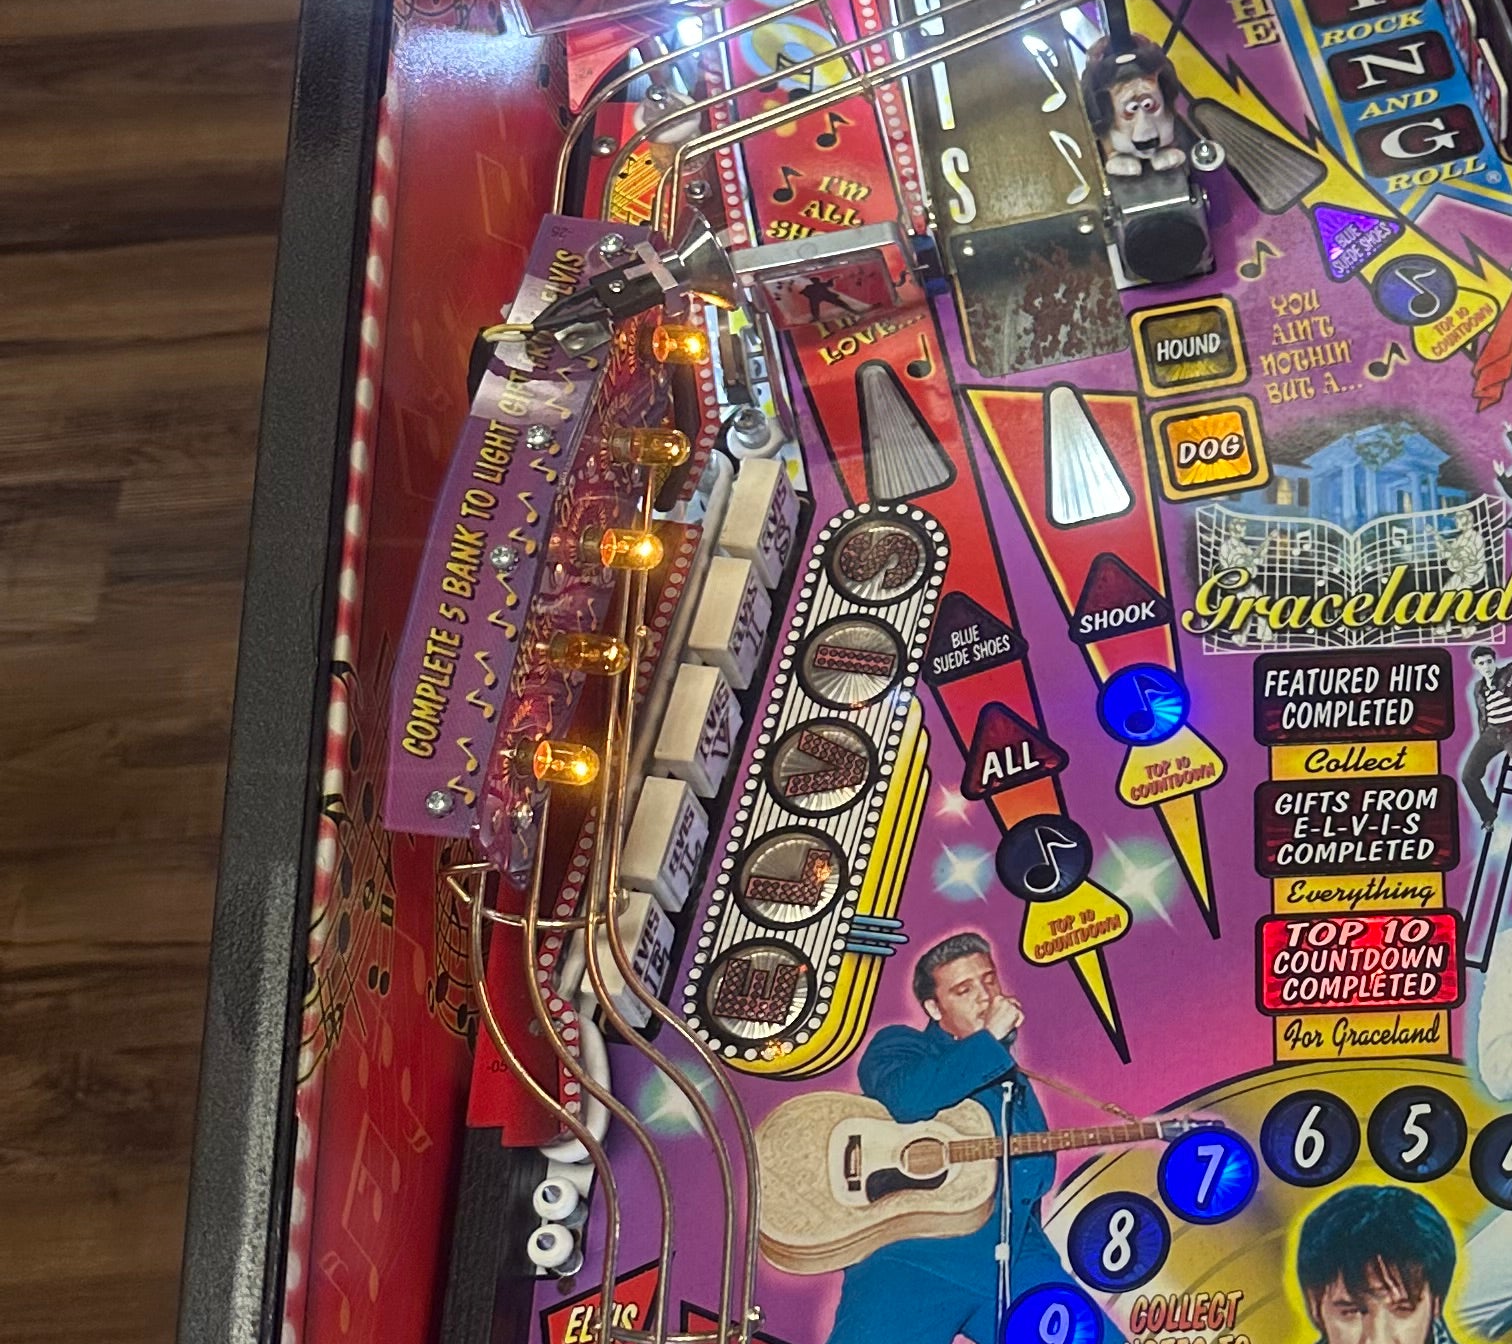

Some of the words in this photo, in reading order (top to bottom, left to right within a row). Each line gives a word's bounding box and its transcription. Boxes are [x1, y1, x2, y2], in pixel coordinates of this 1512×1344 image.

[1320, 9, 1426, 49] ROCK
[1356, 87, 1440, 121] AND
[1383, 158, 1488, 194] ROLL
[801, 202, 865, 229] ALL
[1334, 224, 1362, 249] BLUE
[1270, 288, 1322, 318] YOU
[1271, 314, 1335, 347] AIN'T
[1430, 303, 1495, 358] COUNTDOWN
[1432, 312, 1457, 337] TOP
[1156, 331, 1222, 363] HOUND
[1263, 374, 1316, 406] BUT
[471, 423, 523, 488] LIGHT
[1177, 432, 1246, 466] DOG
[460, 483, 497, 519] TO
[440, 514, 489, 599] BANK
[1079, 600, 1157, 635] SHOOK
[950, 624, 981, 648] BLUE
[933, 648, 971, 674] SUEDE
[972, 634, 1012, 663] SHOES
[400, 622, 466, 759] COMPLETE
[1264, 666, 1381, 698] FEATURED
[1388, 664, 1442, 693] HITS
[1281, 698, 1415, 732] COMPLETED
[980, 740, 1040, 786] ALL
[1143, 759, 1172, 780] TOP
[1175, 755, 1192, 772] 10
[1303, 746, 1409, 775] Collect
[1128, 762, 1216, 803] COUNTDOWN
[1274, 790, 1351, 817] GIFTS
[1361, 786, 1440, 813] FROM
[1293, 812, 1422, 840] E-L-V-I-S
[1276, 837, 1436, 867] COMPLETED
[1286, 875, 1437, 912] Everything
[1033, 912, 1122, 960] COUNTDOWN
[1046, 913, 1075, 937] TOP
[1078, 908, 1096, 926] 10
[1286, 920, 1365, 949] TOP
[1383, 918, 1431, 946] 10
[1272, 944, 1445, 976] COUNTDOWN
[1281, 972, 1438, 1003] COMPLETED
[1283, 1017, 1325, 1052] For
[1332, 1012, 1442, 1057] Graceland
[1292, 1104, 1326, 1170] 6
[1401, 1102, 1432, 1164] 5
[1195, 1143, 1226, 1205] 7
[1101, 1207, 1136, 1273] 8
[1128, 1289, 1245, 1335] COLLECT
